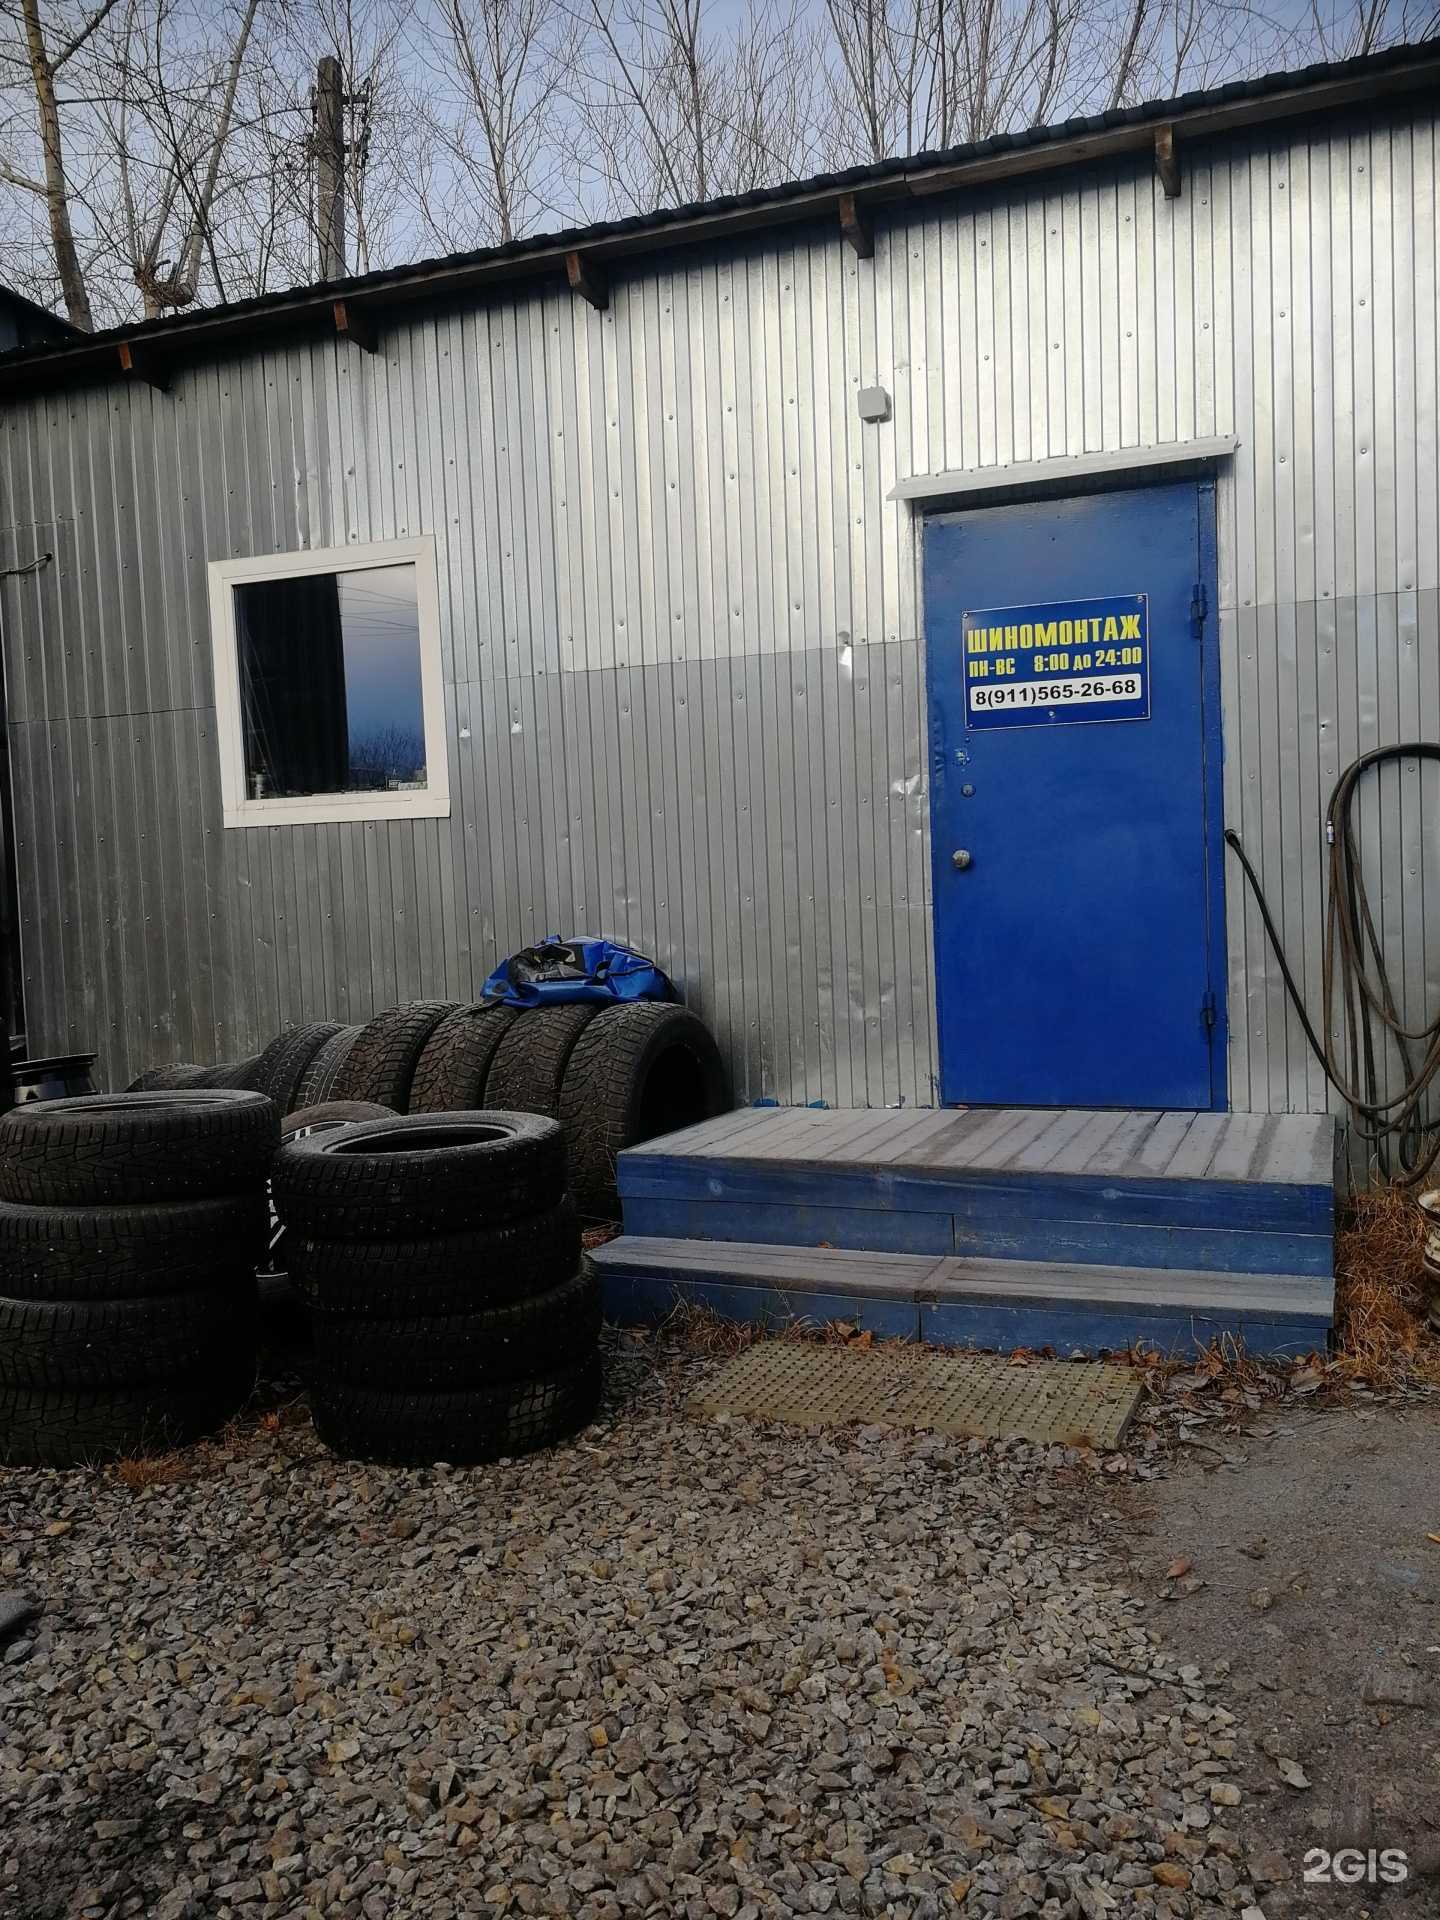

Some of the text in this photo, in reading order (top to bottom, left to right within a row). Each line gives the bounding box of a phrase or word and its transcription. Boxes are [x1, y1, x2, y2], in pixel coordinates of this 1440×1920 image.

[967, 614, 1141, 653] ШИНОМОНТАЖ
[968, 658, 1015, 677] ПН-ВС
[1034, 653, 1069, 672] 8:00
[1095, 647, 1142, 667] 24:00
[975, 679, 1136, 708] 8(911)565-26-68
